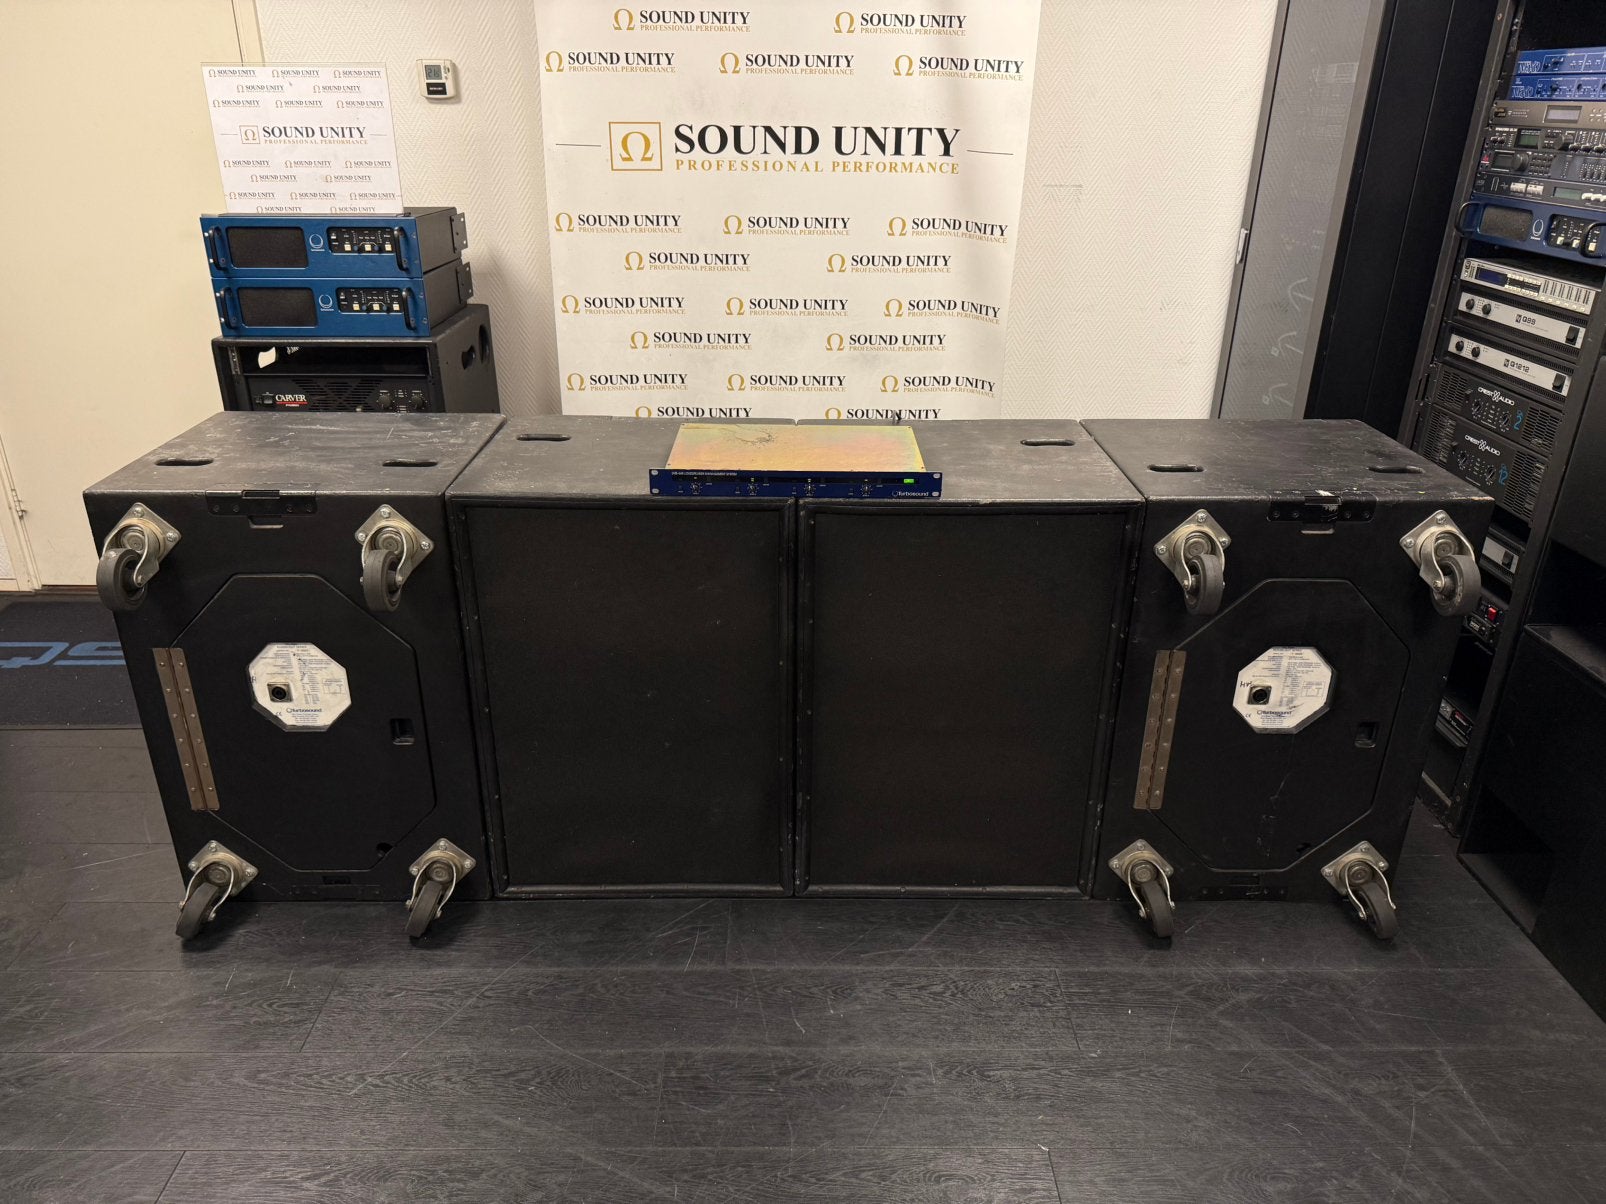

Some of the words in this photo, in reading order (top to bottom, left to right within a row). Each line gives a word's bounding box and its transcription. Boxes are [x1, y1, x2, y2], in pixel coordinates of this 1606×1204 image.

[640, 11, 694, 24] SOUND
[700, 11, 751, 24] UNITY
[860, 13, 914, 26] SOUND
[920, 15, 967, 28] UNITY
[568, 52, 620, 65] SOUND
[625, 52, 675, 66] UNITY
[745, 54, 799, 67] SOUND
[804, 54, 854, 68] UNITY
[919, 56, 970, 70] SOUND
[974, 58, 1024, 73] UNITY
[262, 126, 315, 138] SOUND
[319, 126, 366, 138] UNITY
[674, 124, 820, 155] SOUND
[831, 127, 960, 157] UNITY
[675, 158, 823, 173] PROFESSIONAL
[831, 159, 960, 174] PERFORMANCE
[578, 214, 628, 226] SOUND
[633, 215, 681, 227] UNITY
[748, 216, 798, 229] SOUND
[803, 217, 850, 229] UNITY
[912, 218, 961, 231] SOUND
[965, 220, 1008, 236] UNITY
[649, 252, 699, 265] SOUND
[704, 253, 750, 266] UNITY
[851, 255, 901, 267] SOUND
[906, 255, 951, 268] UNITY
[584, 296, 634, 309] SOUND
[638, 296, 684, 309] UNITY
[749, 298, 798, 310] SOUND
[803, 299, 848, 311] UNITY
[907, 300, 957, 313] SOUND
[961, 301, 1000, 317] UNITY
[1522, 316, 1536, 326] Q99
[654, 332, 702, 344] SOUND
[707, 333, 752, 345] UNITY
[849, 334, 898, 346] SOUND
[902, 334, 946, 347] UNITY
[1510, 360, 1530, 373] Q1212
[590, 374, 639, 385] SOUND
[643, 374, 687, 385] UNITY
[750, 375, 798, 387] SOUND
[802, 376, 846, 387] UNITY
[903, 376, 951, 388] SOUND
[955, 377, 996, 392] UNITY
[1499, 396, 1515, 406] AUDIO
[657, 406, 704, 418] SOUND
[709, 407, 752, 418] UNITY
[1485, 445, 1501, 456] AUDIO
